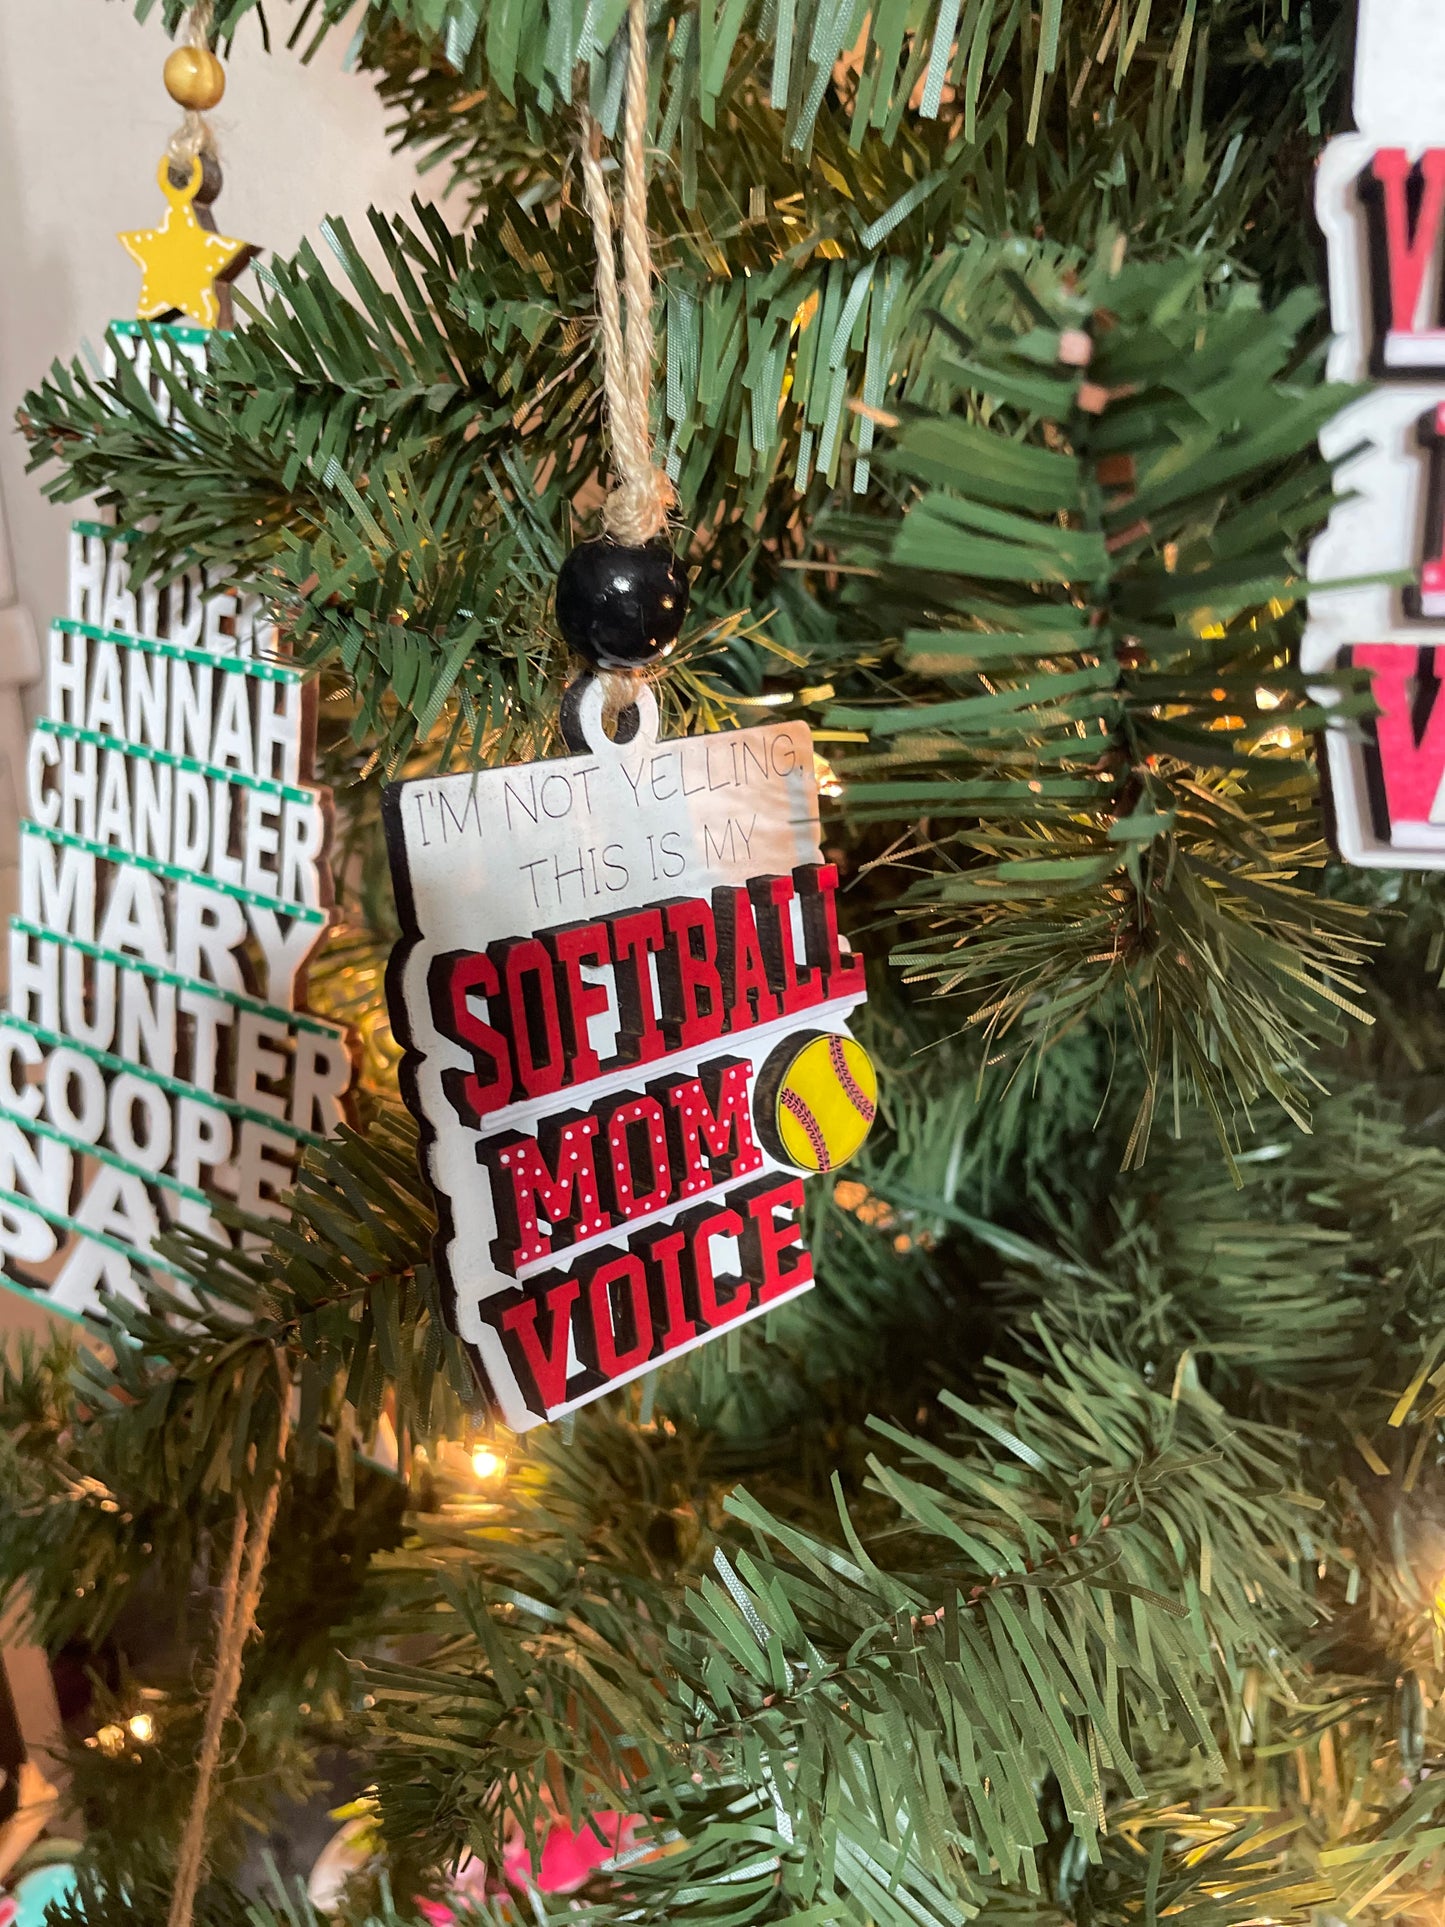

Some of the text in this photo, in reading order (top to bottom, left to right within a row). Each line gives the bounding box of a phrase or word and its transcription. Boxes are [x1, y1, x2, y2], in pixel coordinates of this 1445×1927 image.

[50, 627, 301, 787] HANNAH
[27, 728, 325, 908] CHANDLER
[414, 787, 482, 846] I'M
[503, 767, 600, 831] NOT
[519, 813, 757, 908] THIS IS MY
[19, 833, 327, 1012] MARY
[447, 863, 867, 1118] SOFTBALL
[9, 927, 352, 1142] HUNTER
[499, 1059, 764, 1267] MOM
[502, 1179, 815, 1411] VOICE
